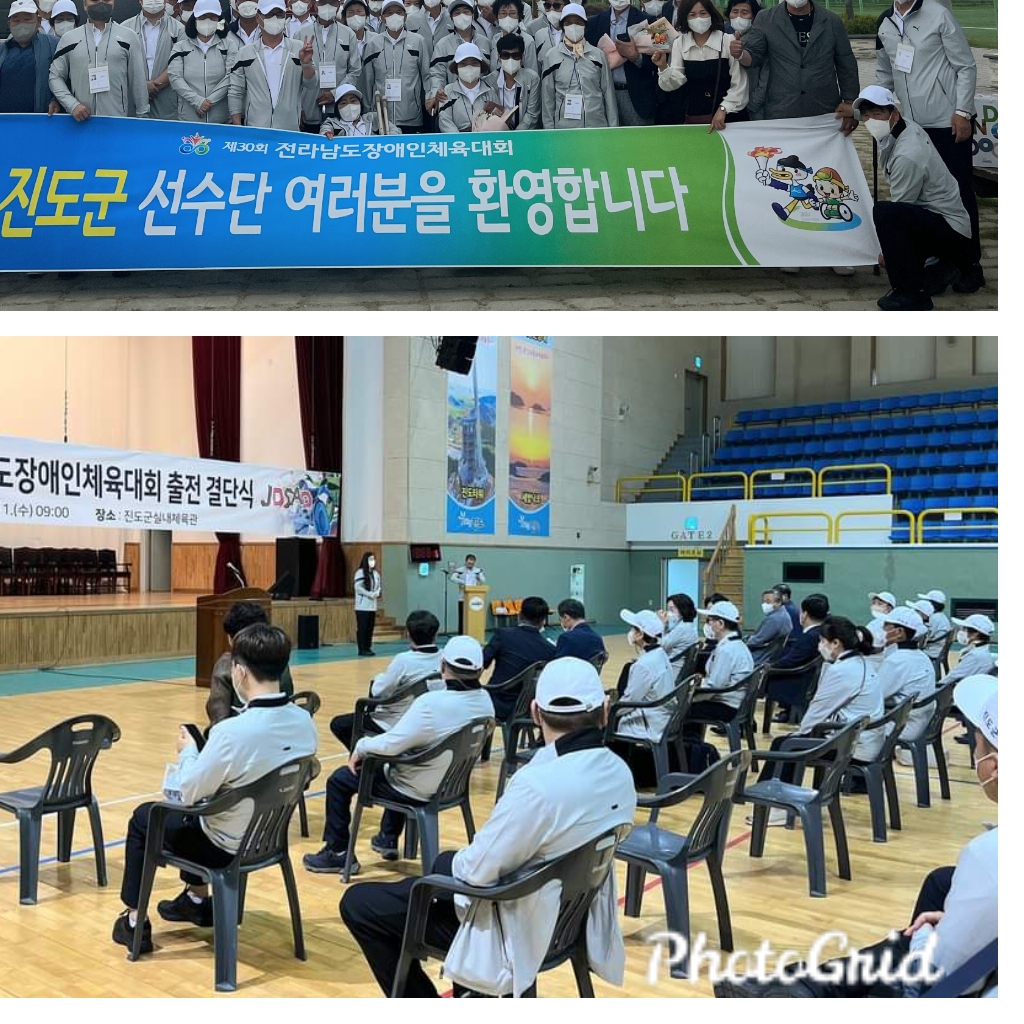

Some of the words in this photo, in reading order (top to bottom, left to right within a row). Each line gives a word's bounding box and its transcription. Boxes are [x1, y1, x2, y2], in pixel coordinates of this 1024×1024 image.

[222, 141, 268, 154] 제30회
[275, 140, 514, 160] 전라남도장애인체육대회
[138, 169, 273, 236] 선수단
[285, 170, 455, 234] 여러분을
[468, 166, 689, 236] 환영합니다
[166, 473, 201, 506] 출전
[206, 476, 254, 509] 결단식
[36, 505, 70, 519] 09:00
[95, 508, 117, 522] 장소
[124, 509, 198, 526] 진도군실내체육관
